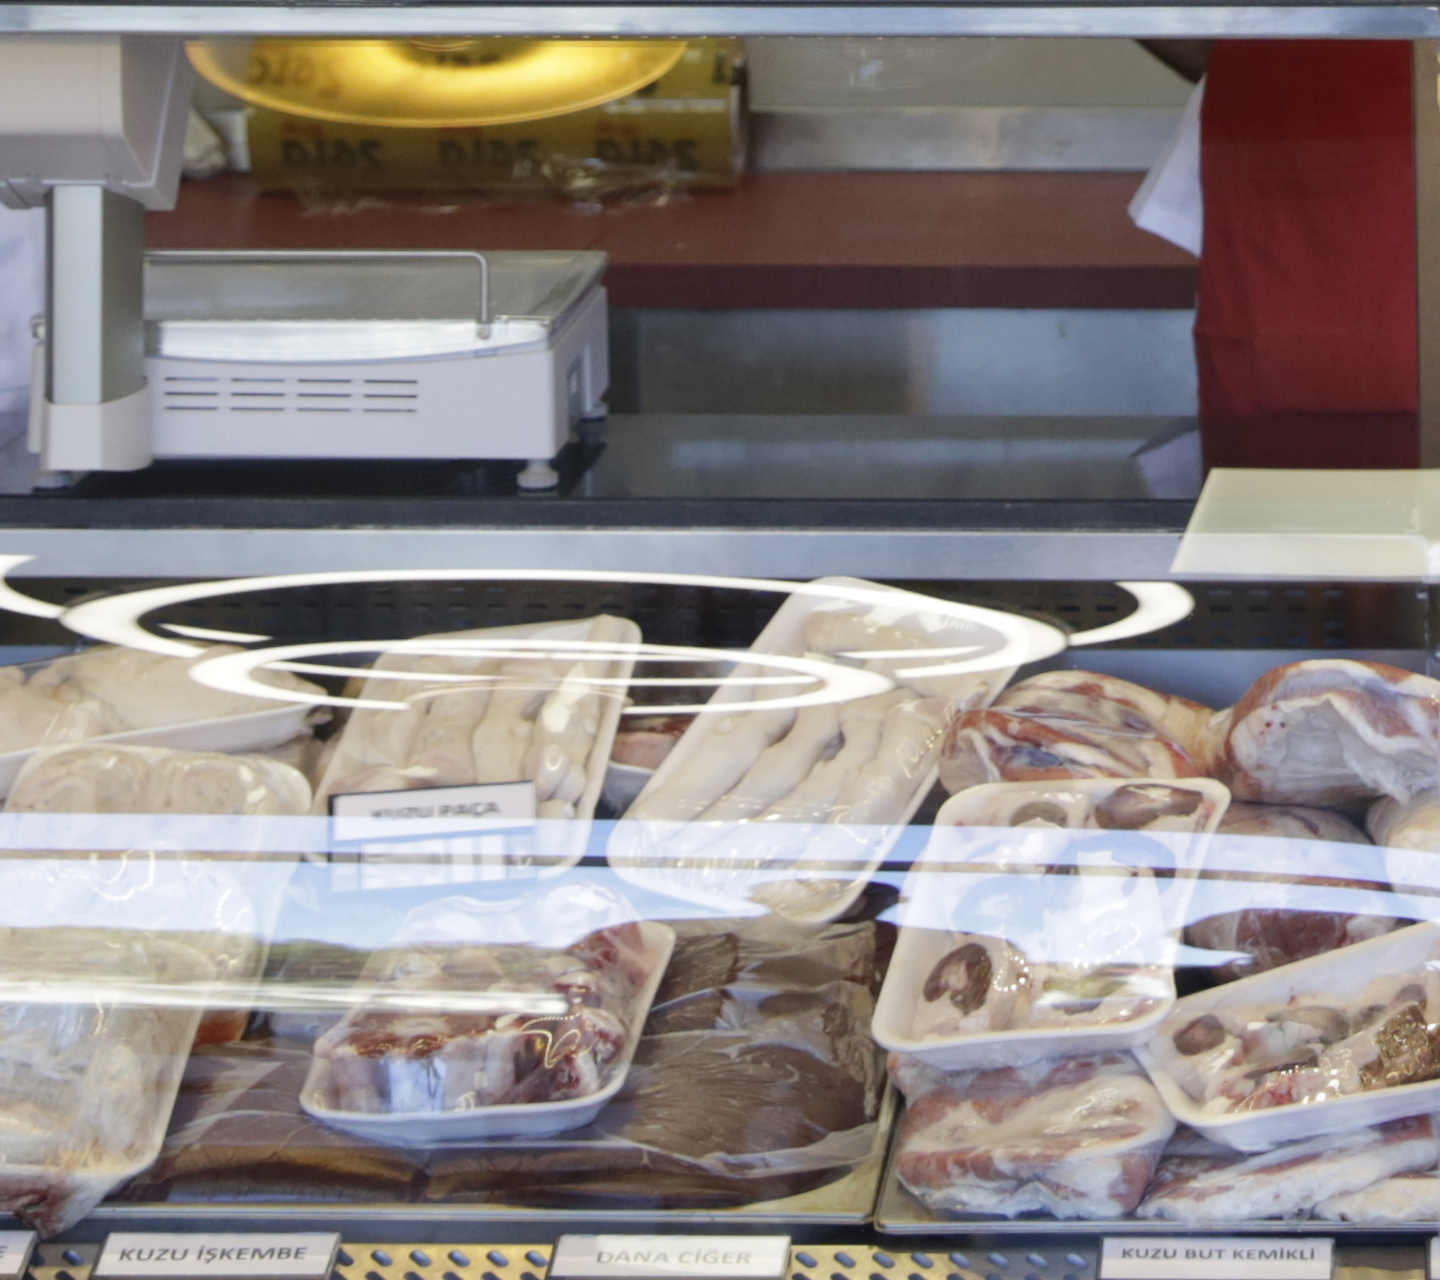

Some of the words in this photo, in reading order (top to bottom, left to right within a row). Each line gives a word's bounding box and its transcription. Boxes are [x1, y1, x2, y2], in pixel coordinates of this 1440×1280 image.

[118, 1247, 190, 1262] KUZU
[196, 1243, 308, 1263] İŞKEMBE
[596, 1250, 669, 1265] DANA
[678, 1247, 751, 1265] CİĞER
[1121, 1248, 1177, 1261] KUZU
[1184, 1248, 1226, 1261] BUT
[1233, 1246, 1315, 1261] KEMİKLİ
